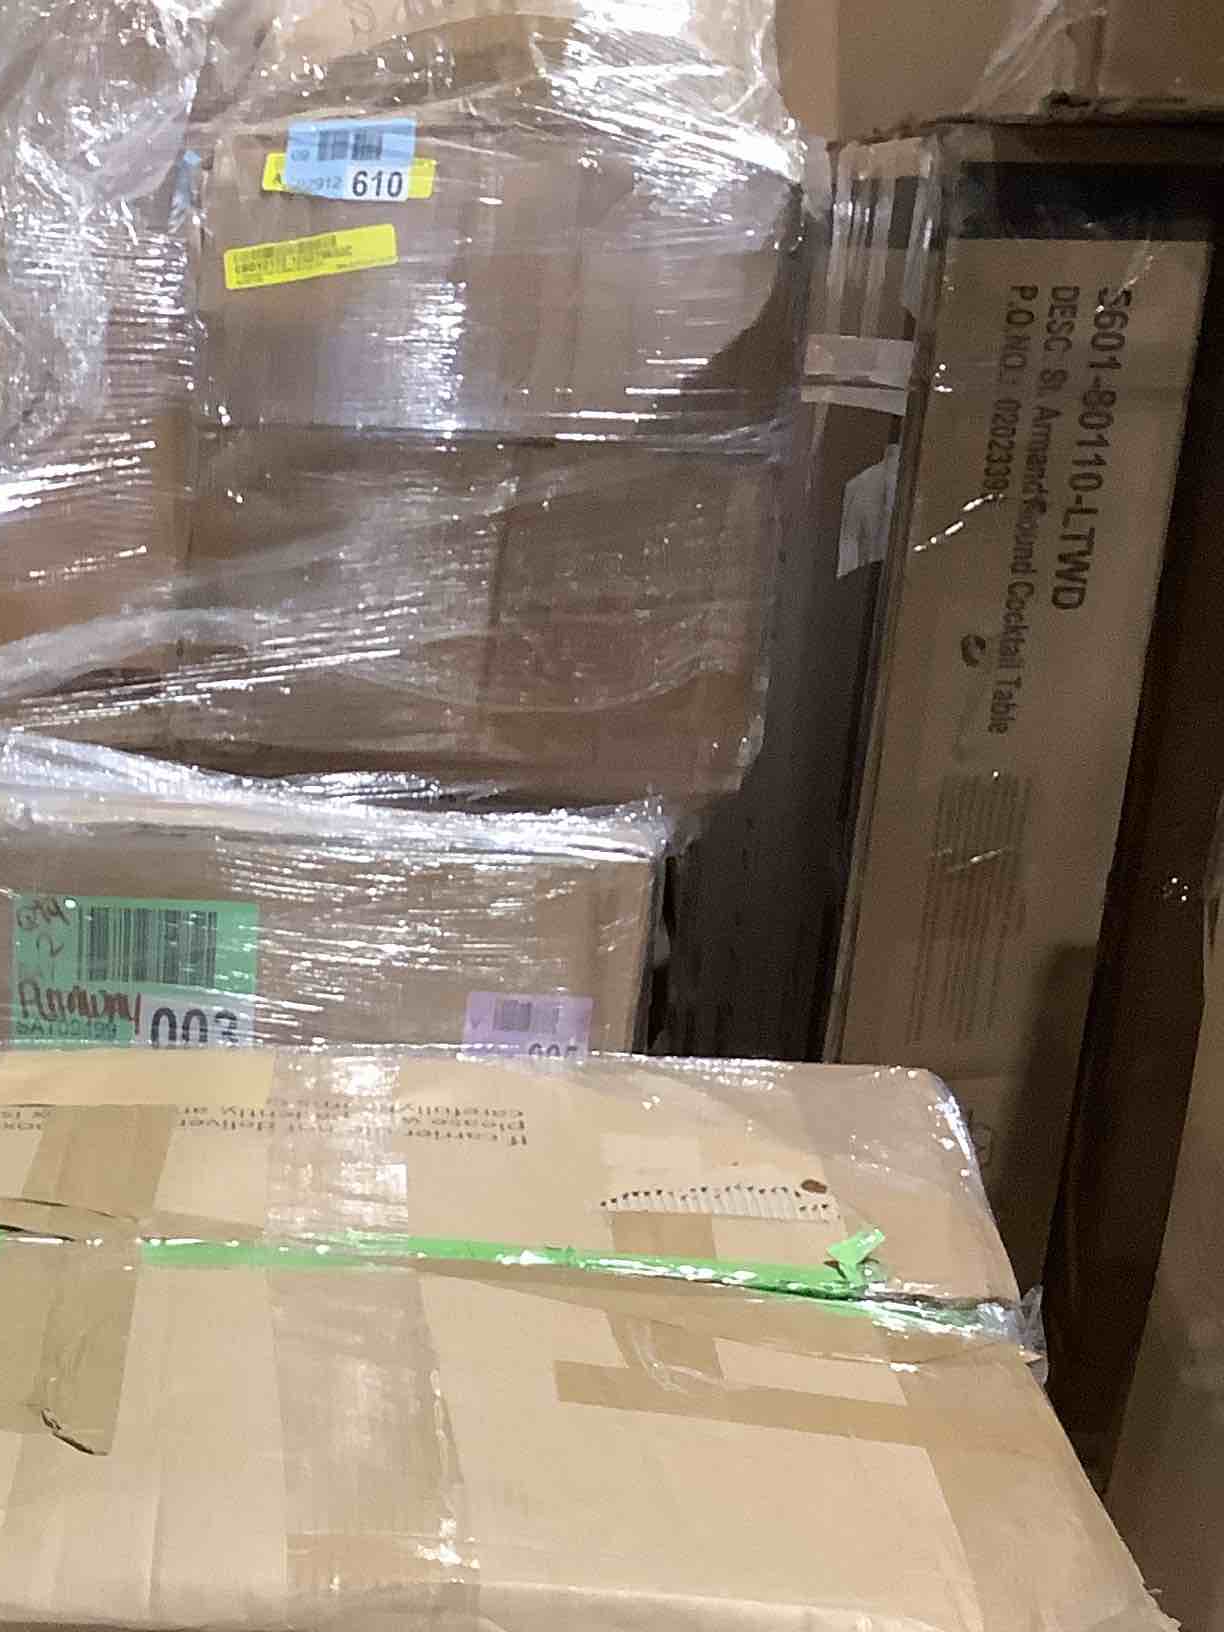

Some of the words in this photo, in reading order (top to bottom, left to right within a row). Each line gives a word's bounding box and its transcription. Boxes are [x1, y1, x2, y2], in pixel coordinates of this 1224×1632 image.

[351, 170, 403, 198] 610
[997, 580, 1035, 671] Cocktail
[987, 676, 1022, 736] Table
[176, 1119, 275, 1132] deliver
